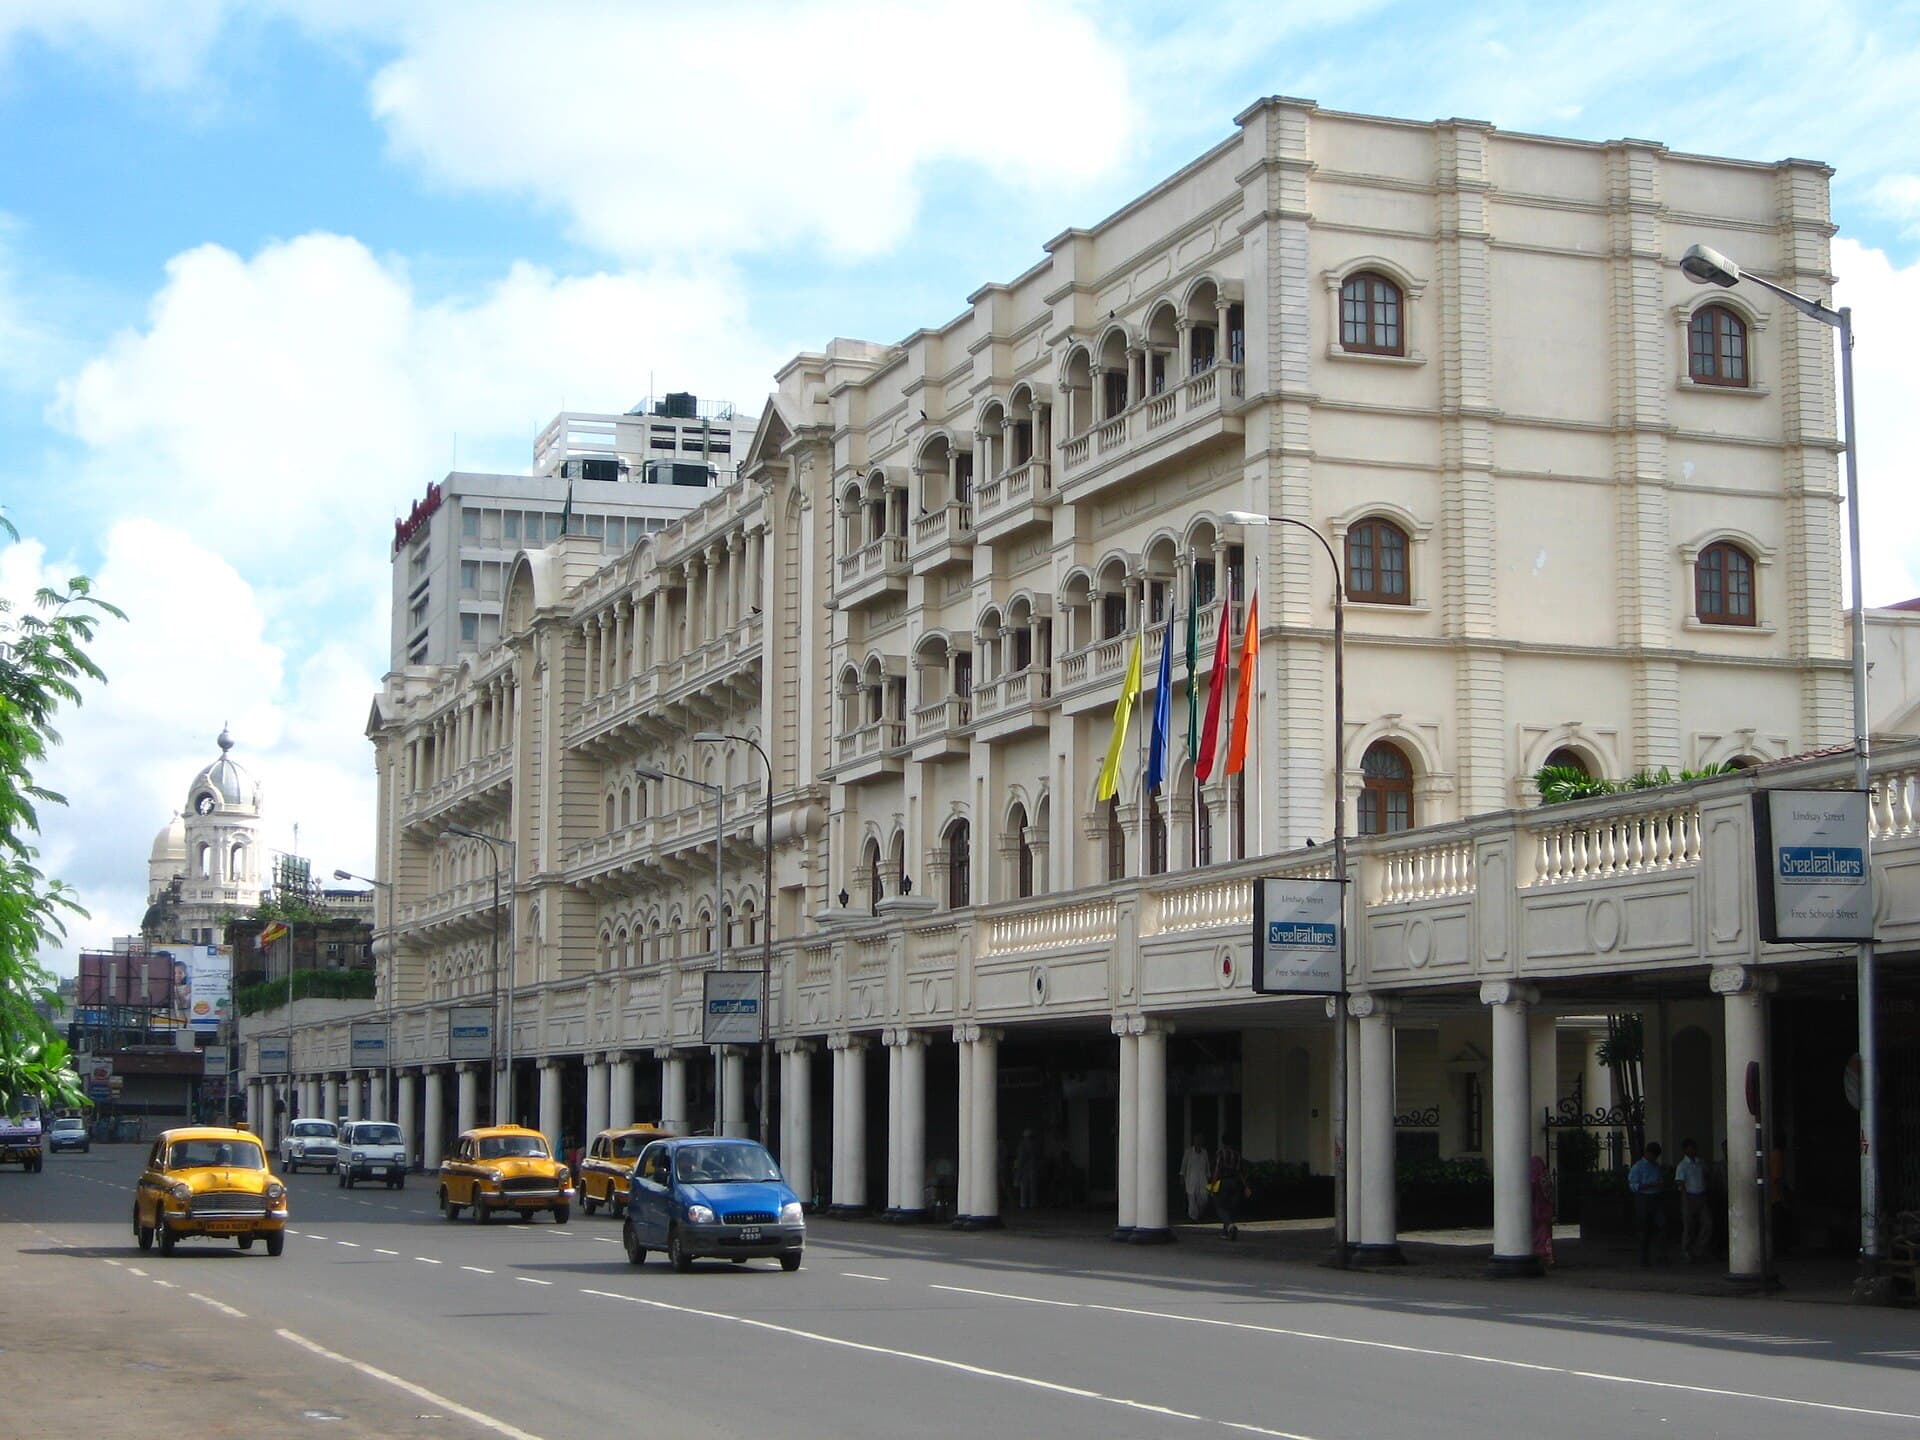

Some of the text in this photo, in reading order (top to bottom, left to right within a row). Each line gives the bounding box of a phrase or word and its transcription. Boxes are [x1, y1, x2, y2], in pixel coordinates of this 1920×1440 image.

[1792, 810, 1845, 823] Lindsay Street
[1782, 850, 1861, 874] Sreeleathers
[1791, 908, 1858, 920] Free School Street
[1271, 925, 1334, 944] Sreeleathers
